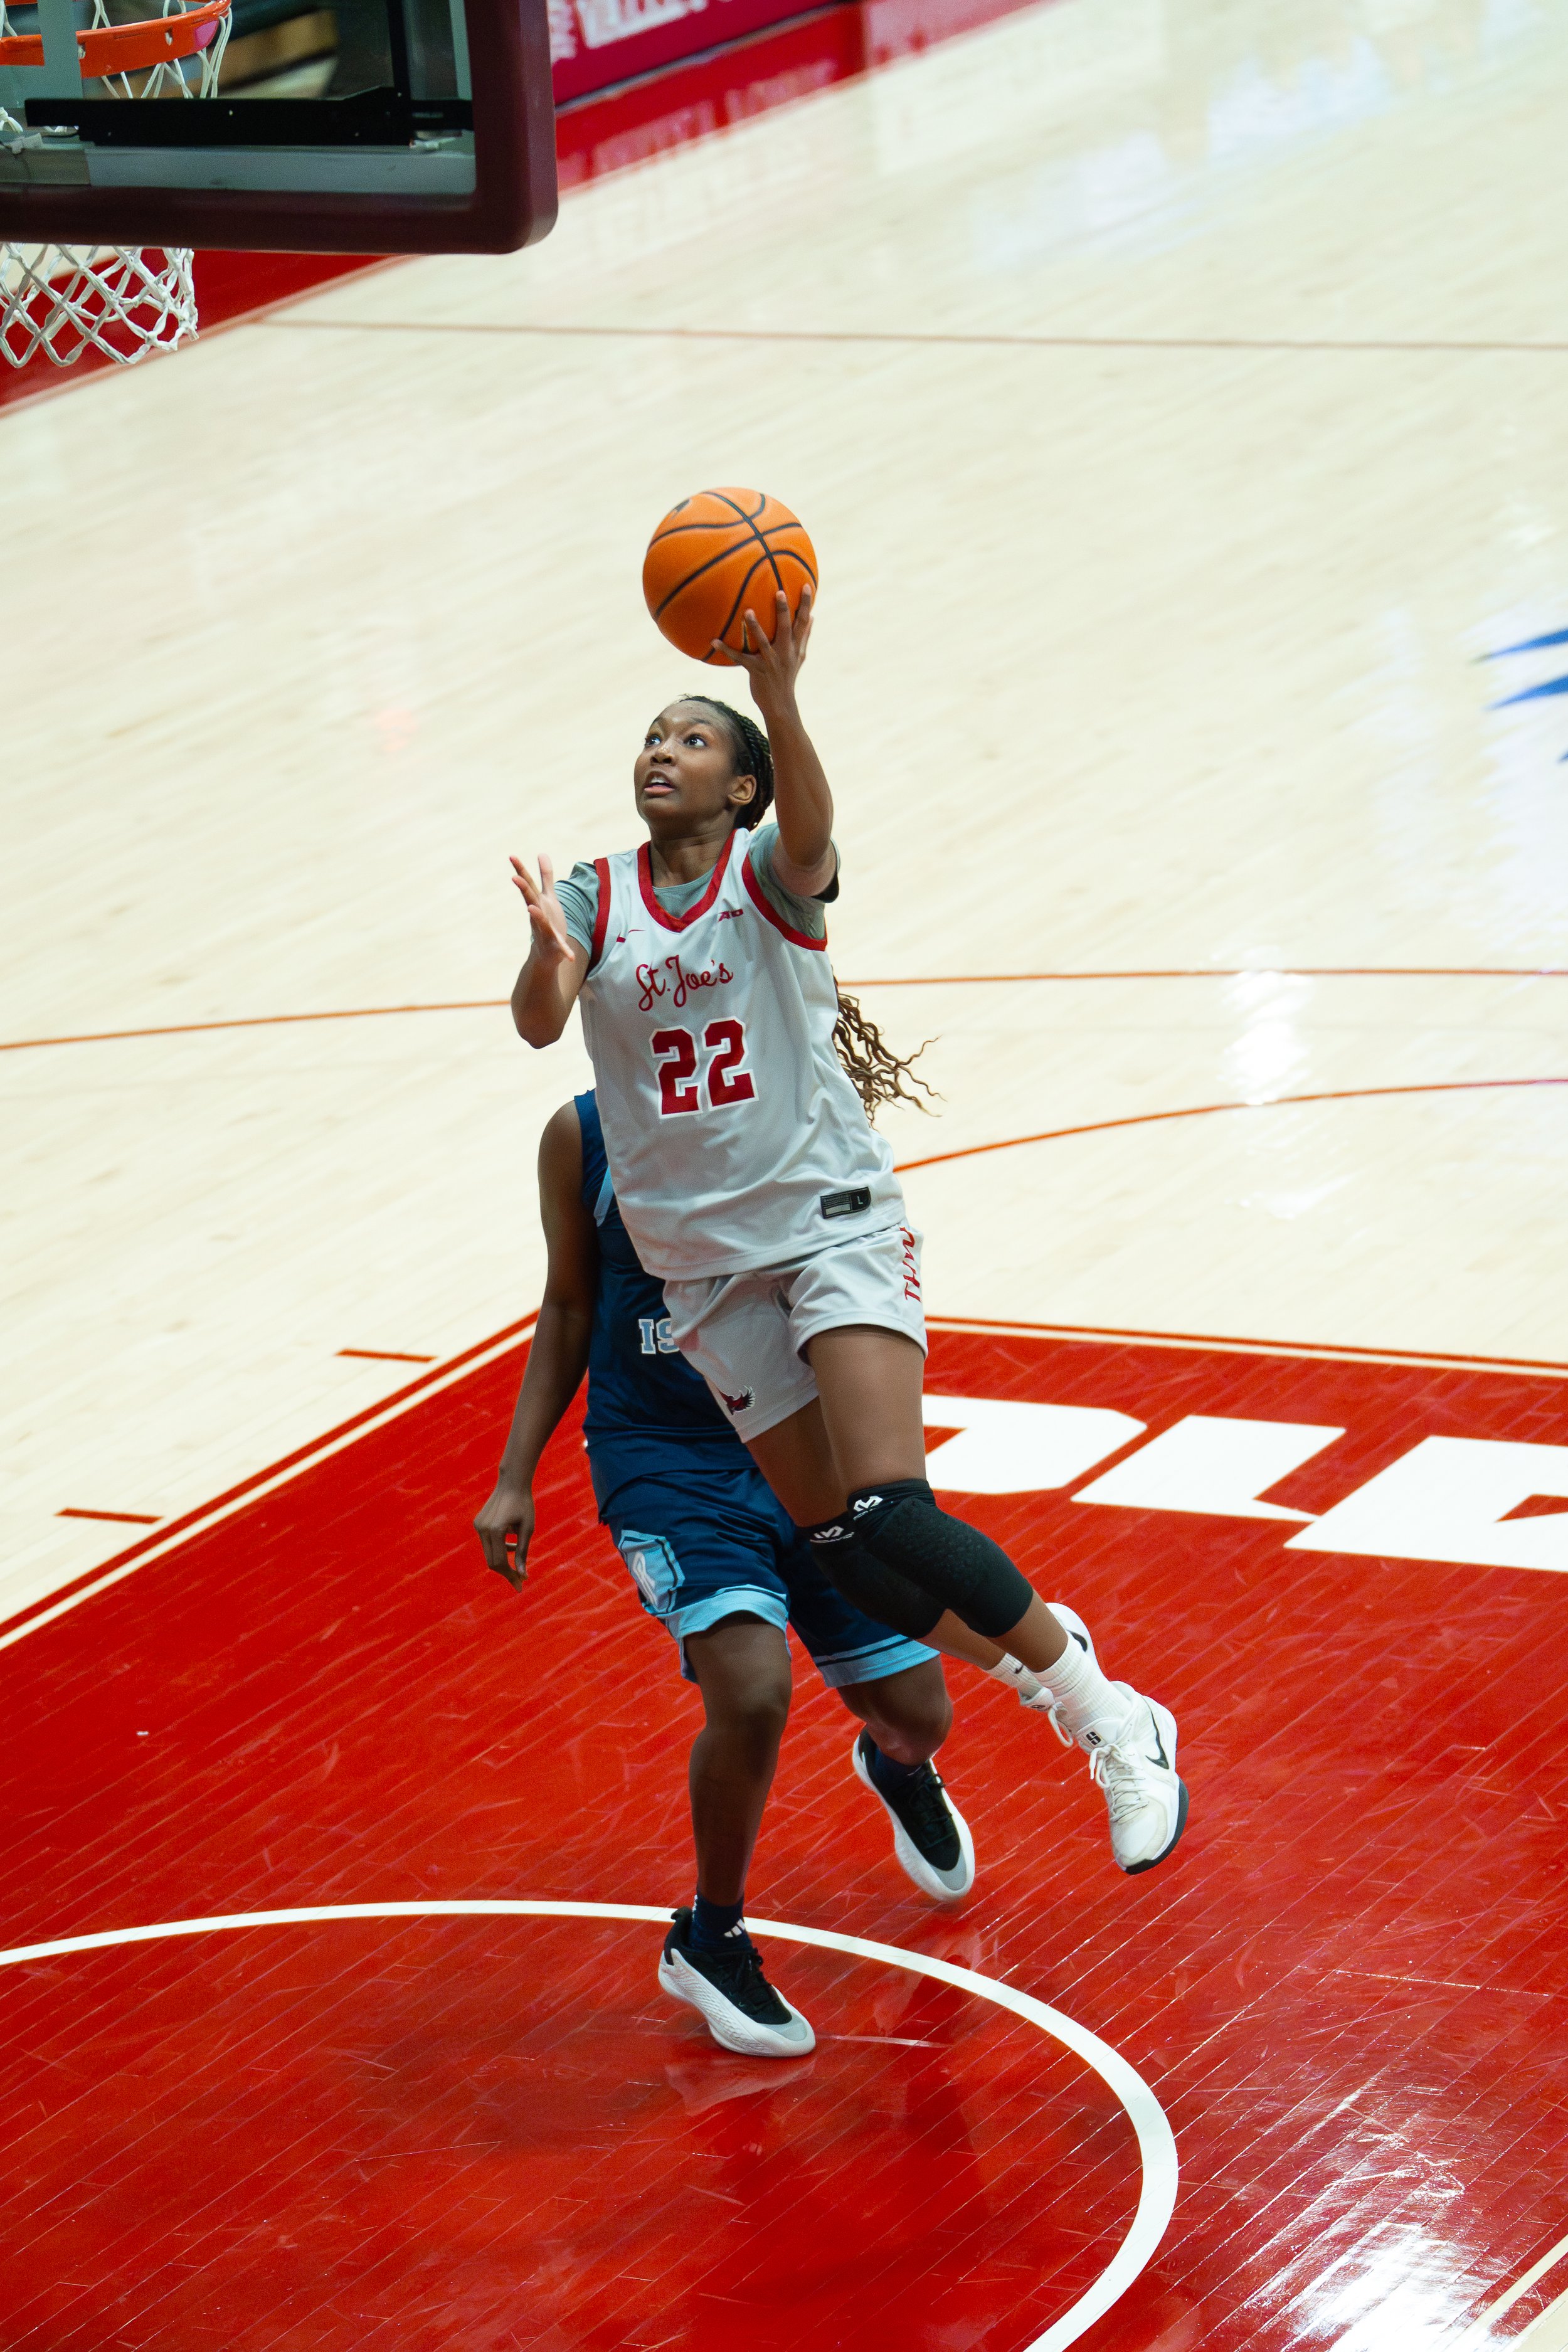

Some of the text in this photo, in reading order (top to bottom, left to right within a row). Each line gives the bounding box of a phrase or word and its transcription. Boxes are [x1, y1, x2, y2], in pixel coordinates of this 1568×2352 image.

[635, 955, 734, 1012] St. Joe's
[650, 1016, 759, 1119] 22
[857, 1195, 864, 1204] L
